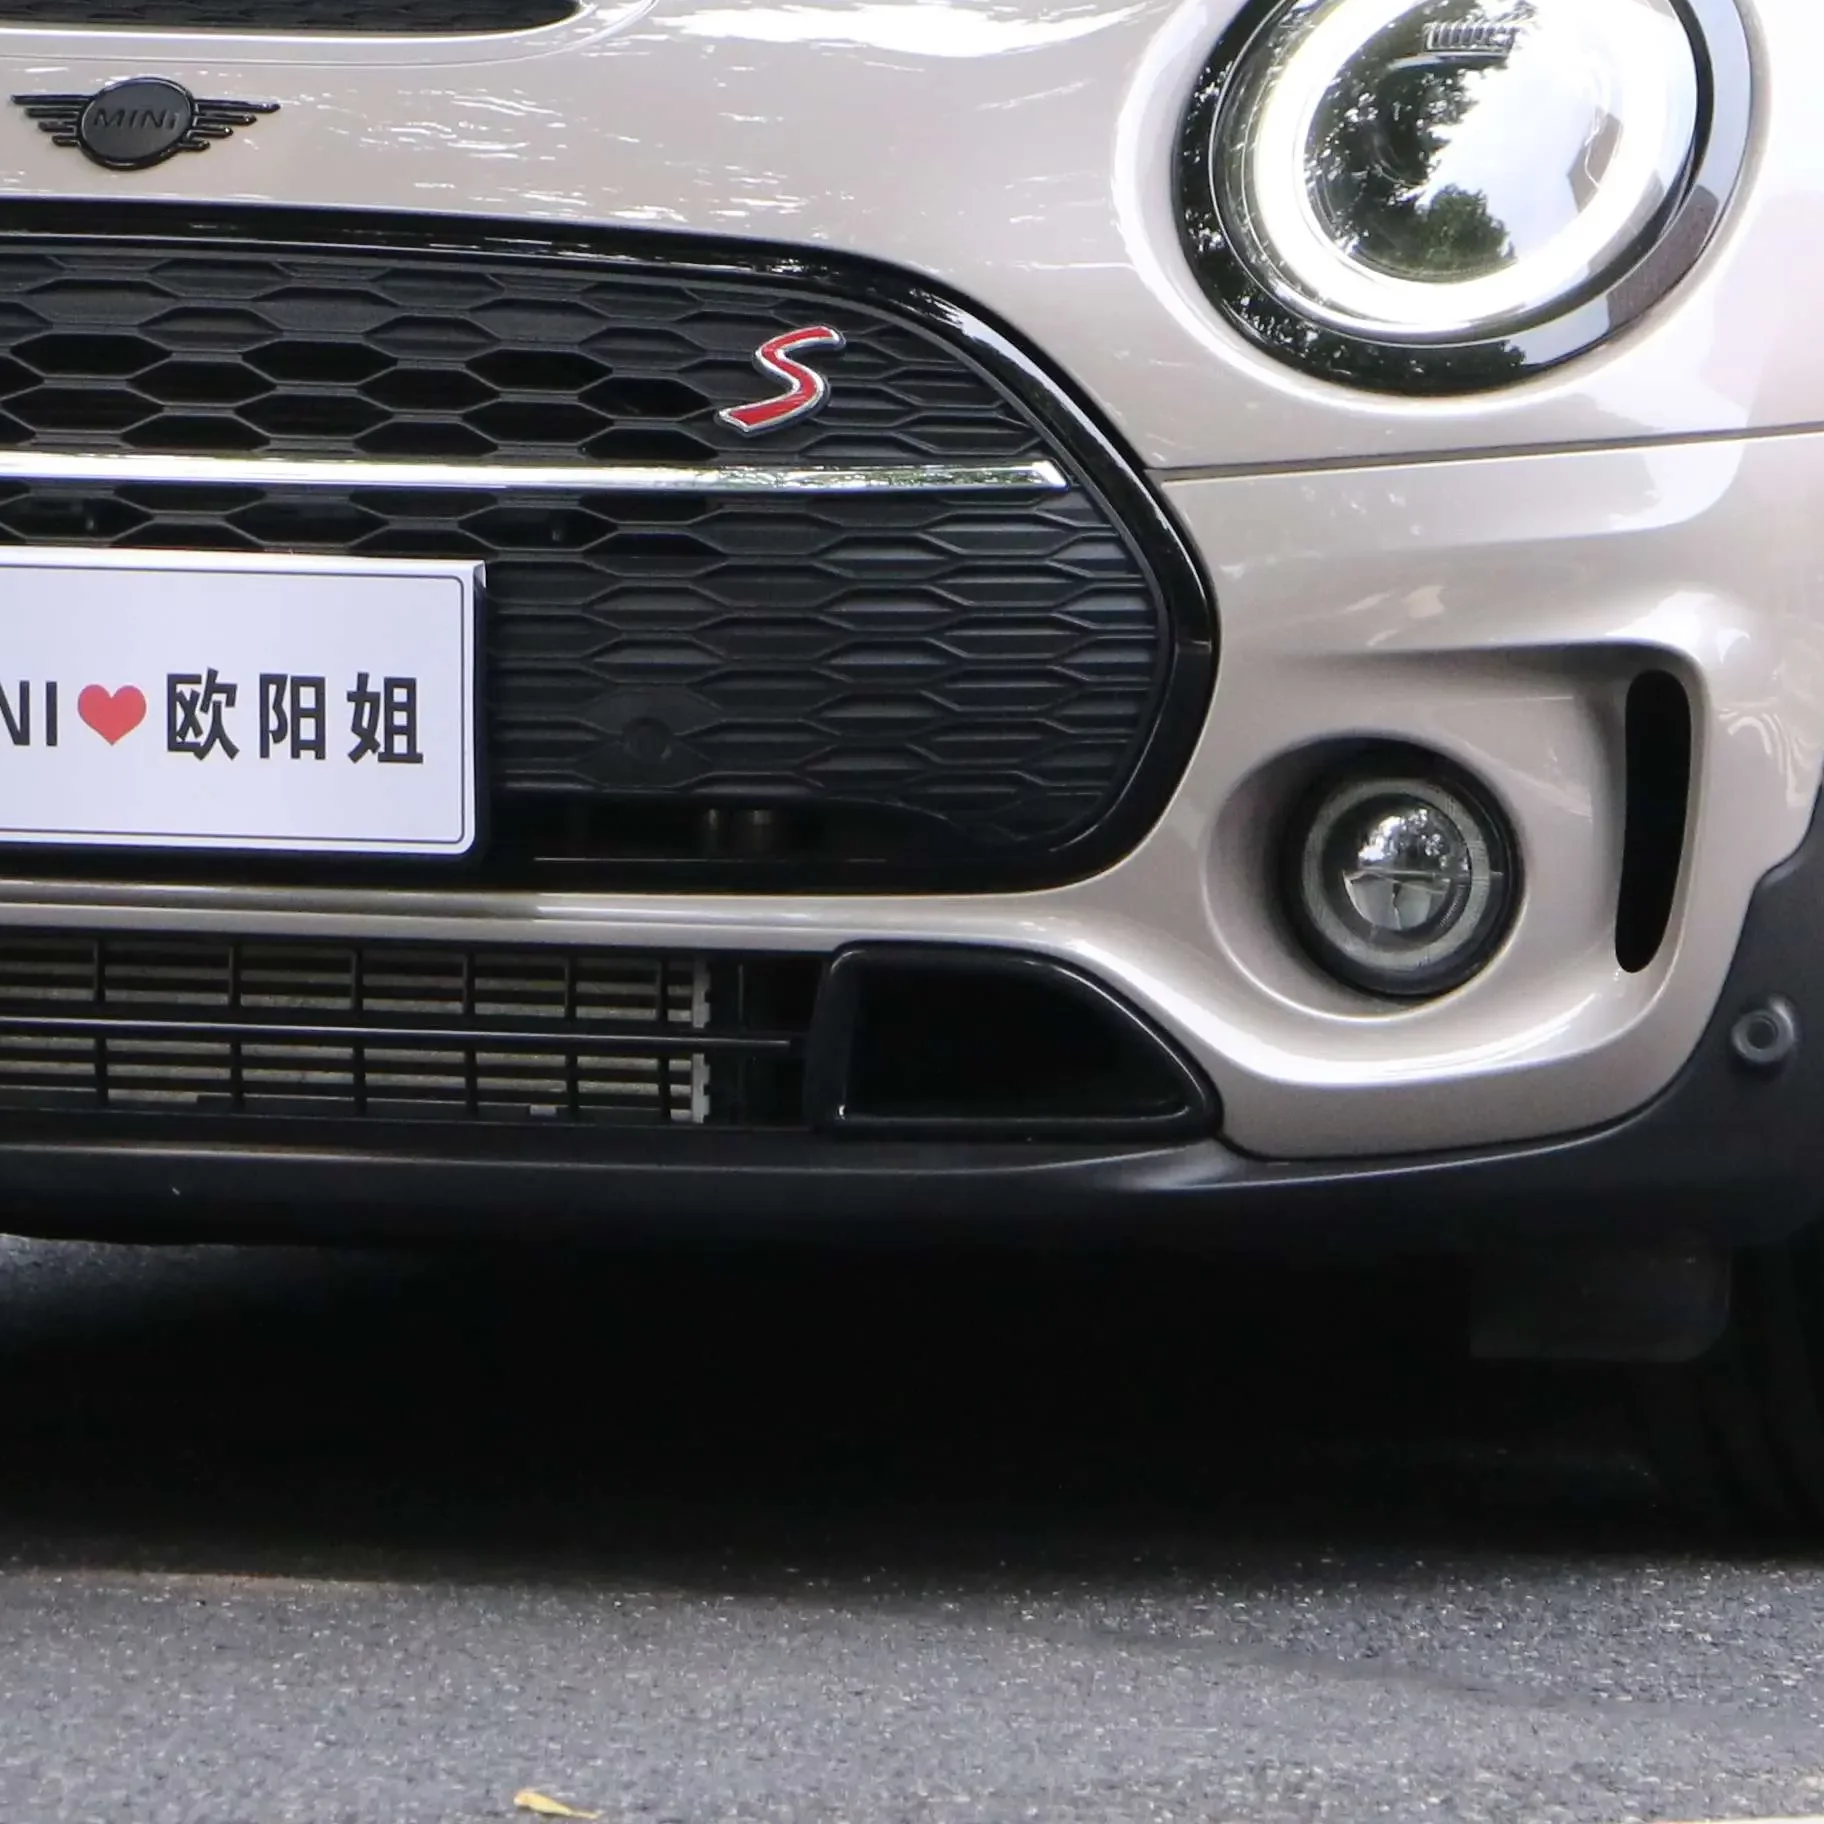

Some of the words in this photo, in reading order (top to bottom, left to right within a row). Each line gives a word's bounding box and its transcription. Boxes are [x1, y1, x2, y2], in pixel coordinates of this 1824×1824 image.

[93, 107, 180, 131] MINI
[716, 325, 846, 438] S
[165, 667, 424, 765] 欧阳姐
